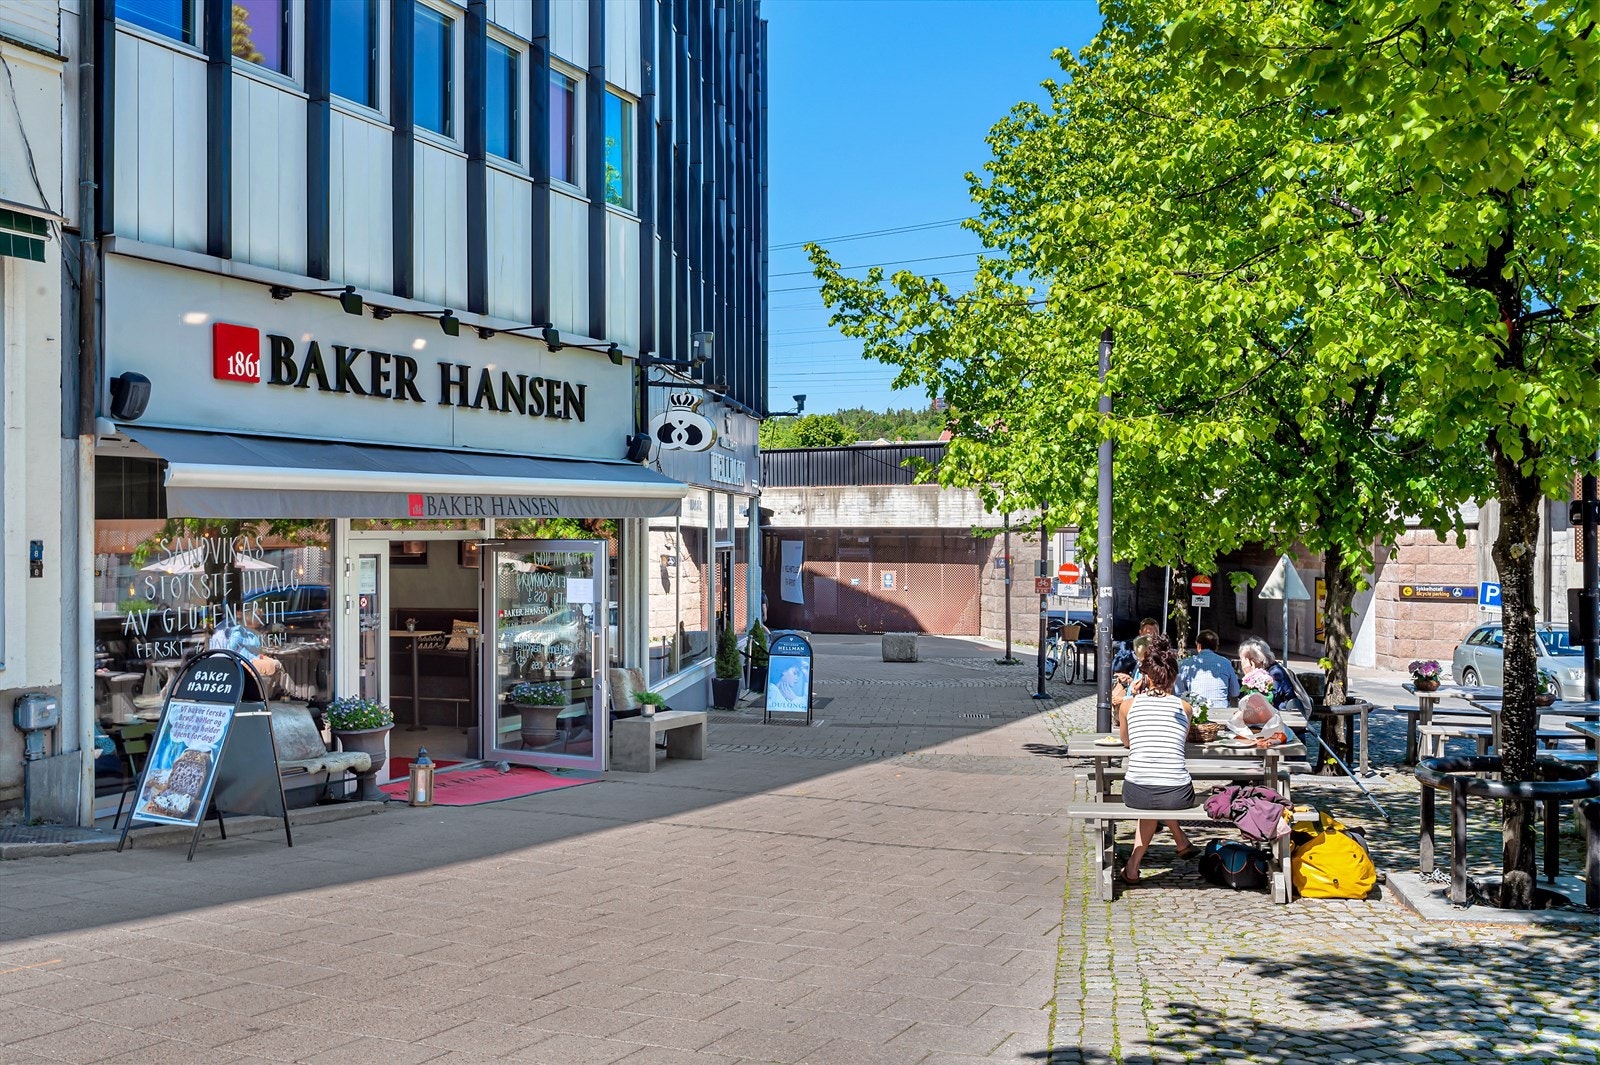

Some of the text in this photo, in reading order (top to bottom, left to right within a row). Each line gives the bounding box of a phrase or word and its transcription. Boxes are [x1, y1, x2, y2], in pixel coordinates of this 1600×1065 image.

[227, 351, 260, 378] 1861
[266, 334, 587, 422] BAKER HANSEN
[426, 495, 560, 517] BAKER HANSEN
[34, 550, 39, 558] 8
[158, 535, 265, 566] SANDVIKAS
[145, 569, 299, 600] STØRSTE UTVALG
[1486, 585, 1500, 602] P
[122, 610, 151, 636] AV
[136, 641, 184, 658] FERSKT
[206, 709, 226, 718] ferske
[213, 719, 222, 727] og
